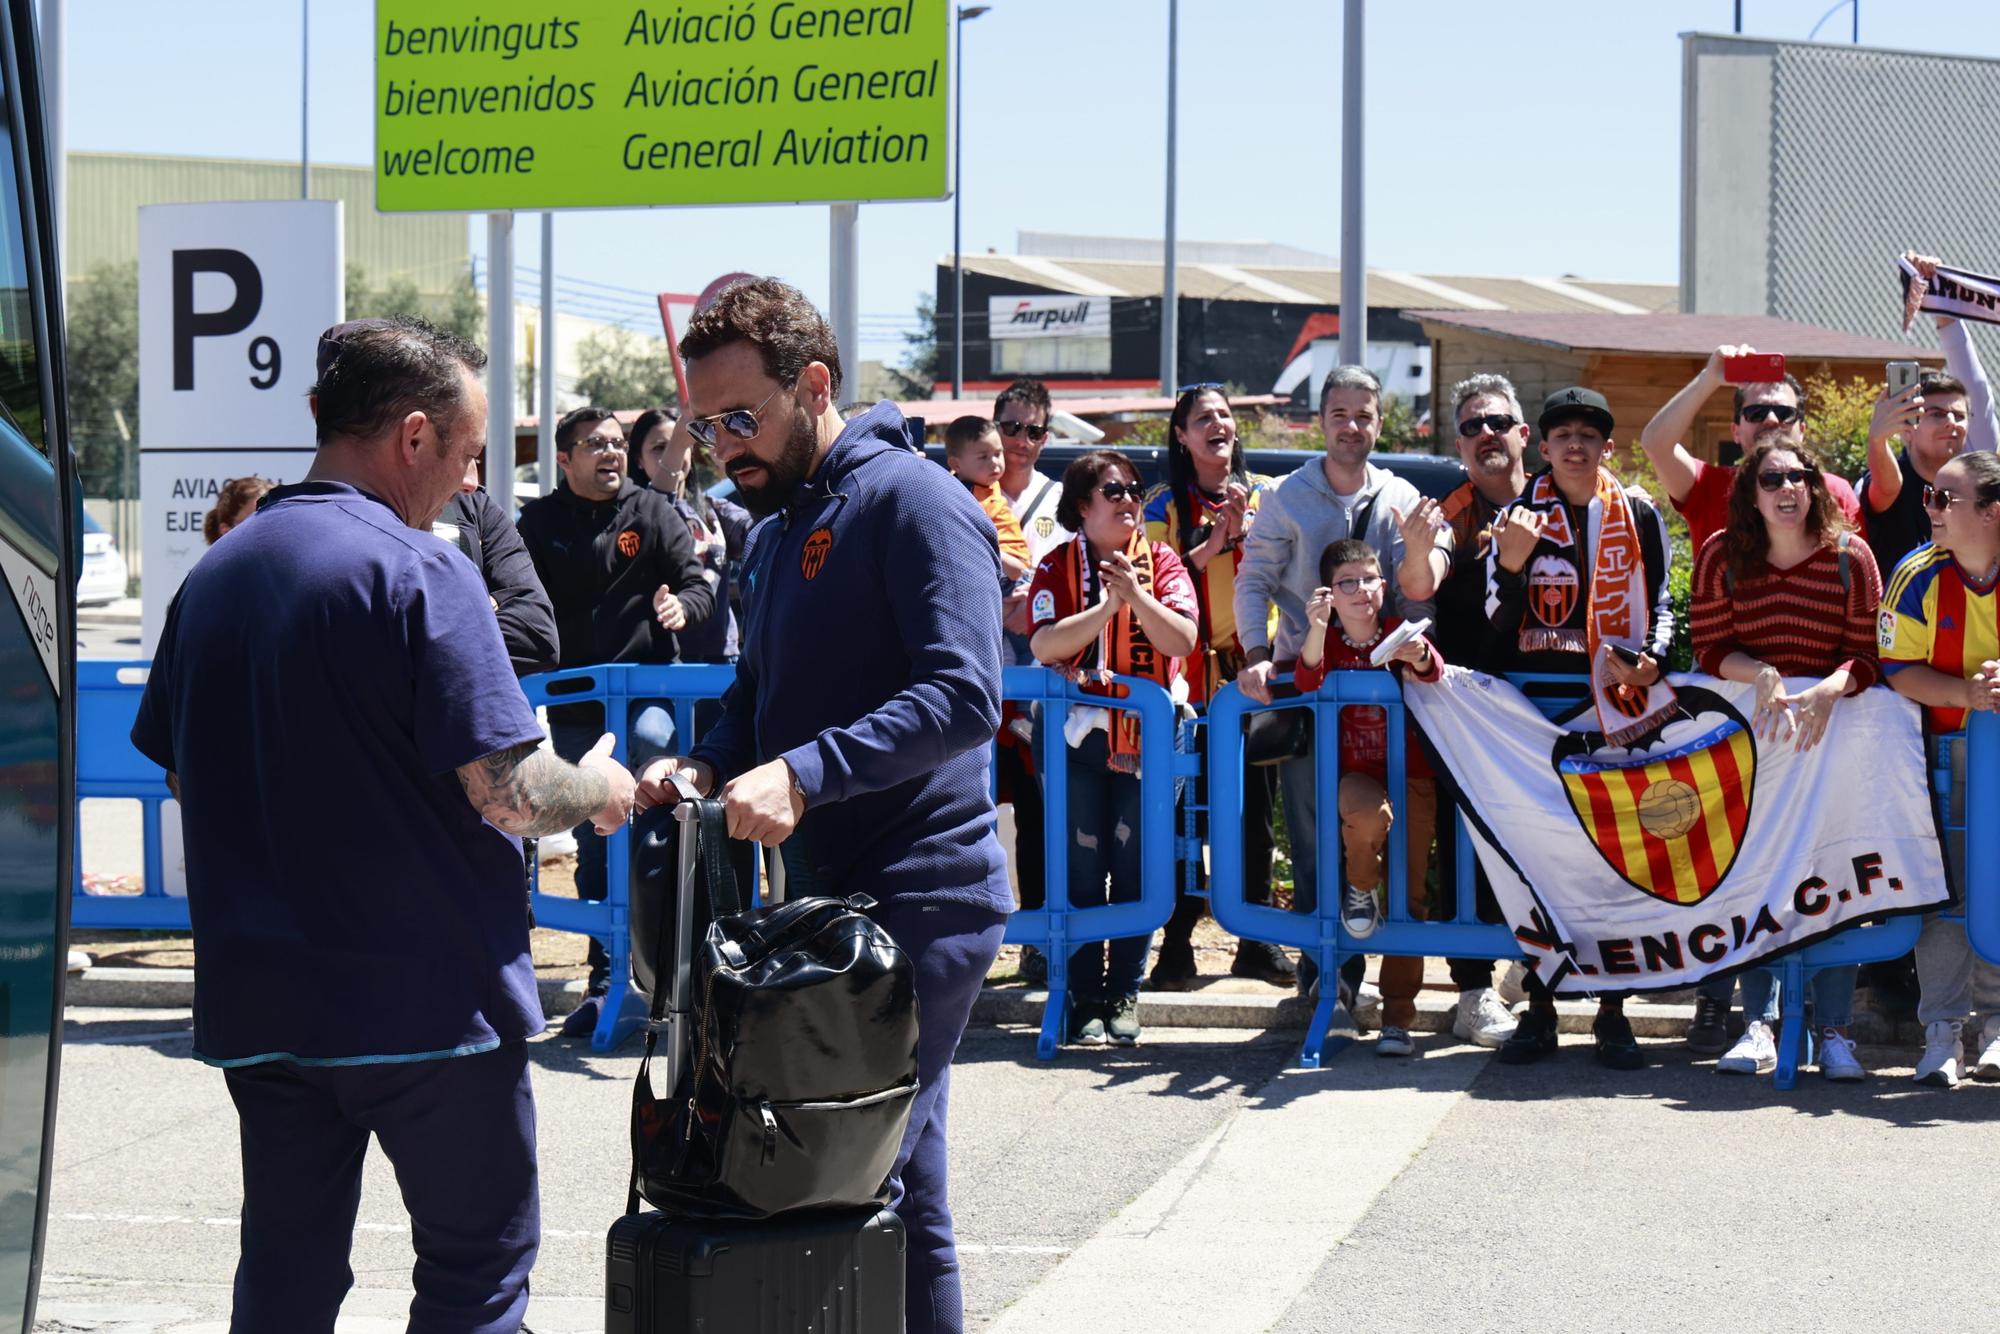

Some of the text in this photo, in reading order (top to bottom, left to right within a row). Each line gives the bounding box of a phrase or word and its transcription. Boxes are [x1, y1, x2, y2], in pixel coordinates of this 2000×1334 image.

[386, 17, 579, 59] benvinguts
[624, 0, 914, 47] Aviació General
[386, 75, 595, 116] bienvenidos
[624, 60, 938, 108] Aviación General
[384, 140, 533, 177] welcome
[624, 126, 927, 170] General Aviation
[1922, 274, 2000, 310] AMUN
[1010, 301, 1090, 330] Airpull
[23, 575, 54, 653] noge
[1878, 634, 1892, 648] FP
[1515, 851, 1903, 976] VLENCIA C.F.
